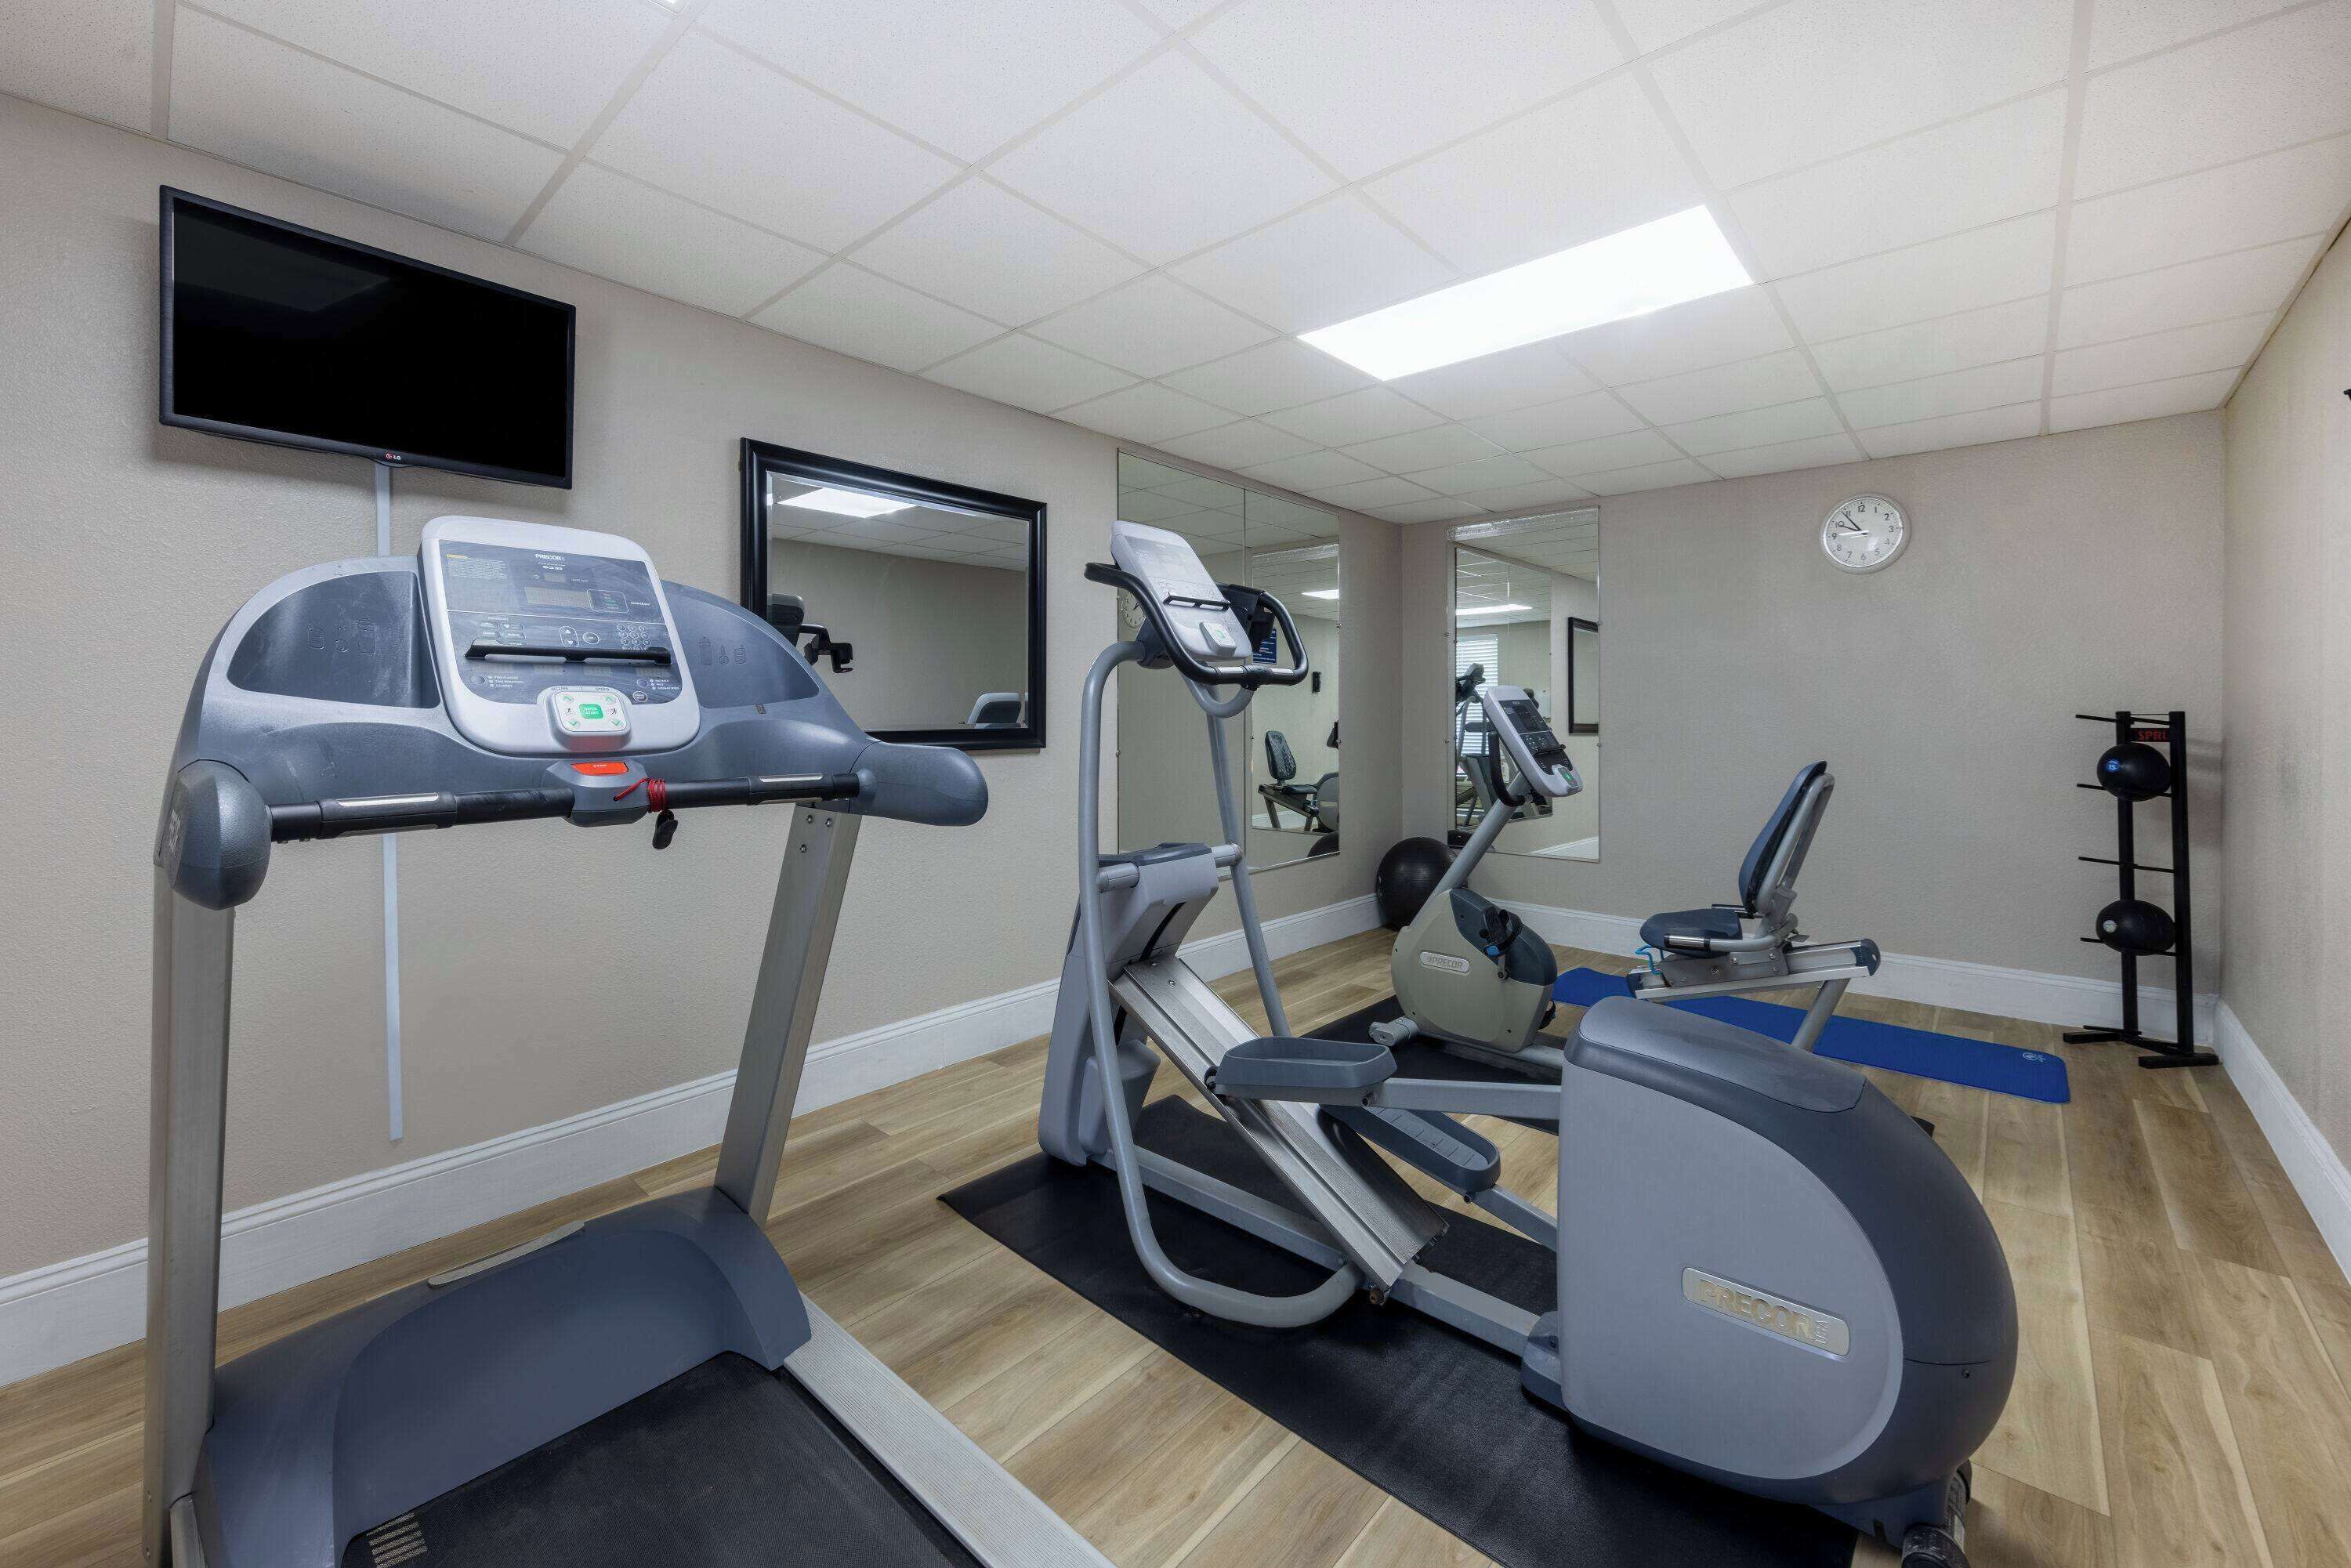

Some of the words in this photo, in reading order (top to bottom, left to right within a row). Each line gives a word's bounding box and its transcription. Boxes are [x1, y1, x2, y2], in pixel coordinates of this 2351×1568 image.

[2137, 730, 2168, 741] SPRI
[1432, 957, 1463, 969] PRECOR
[1697, 1278, 1817, 1341] PRECOR
